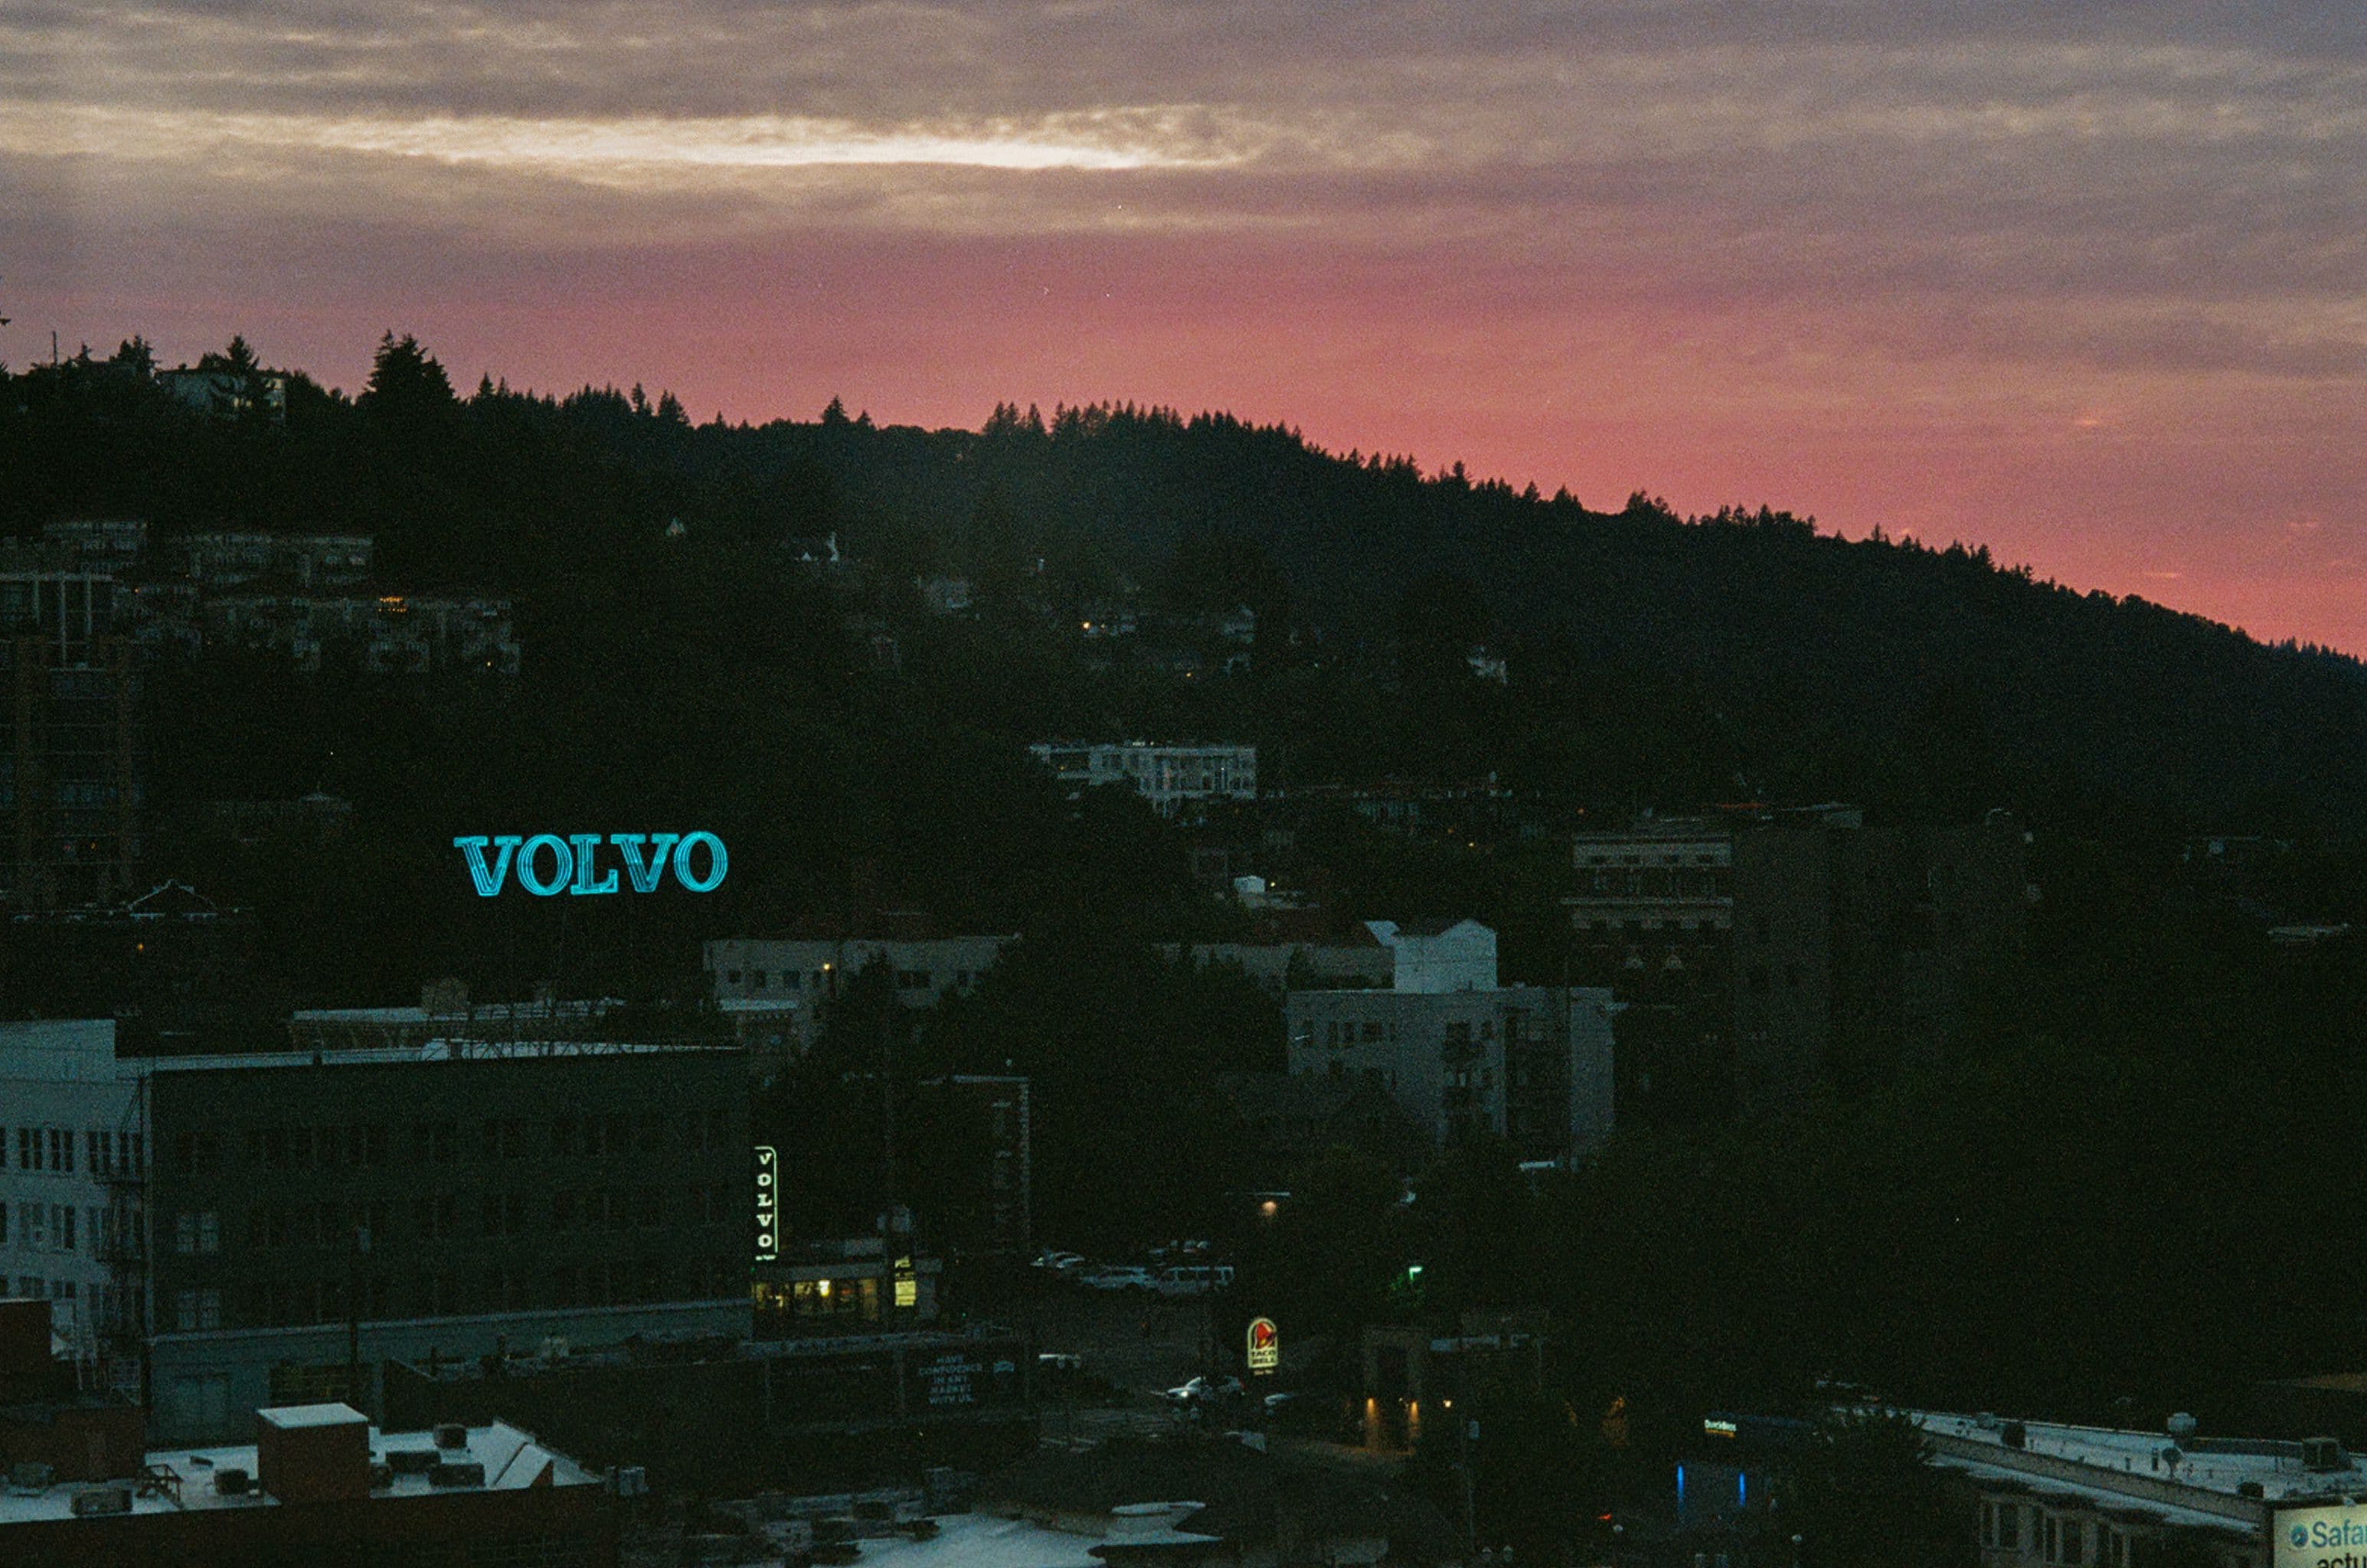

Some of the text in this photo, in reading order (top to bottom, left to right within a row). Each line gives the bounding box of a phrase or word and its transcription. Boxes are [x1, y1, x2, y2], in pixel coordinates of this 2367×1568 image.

[453, 831, 728, 897] VOLVO
[757, 1152, 773, 1248] VOLVO
[2311, 1518, 2367, 1548] Safa
